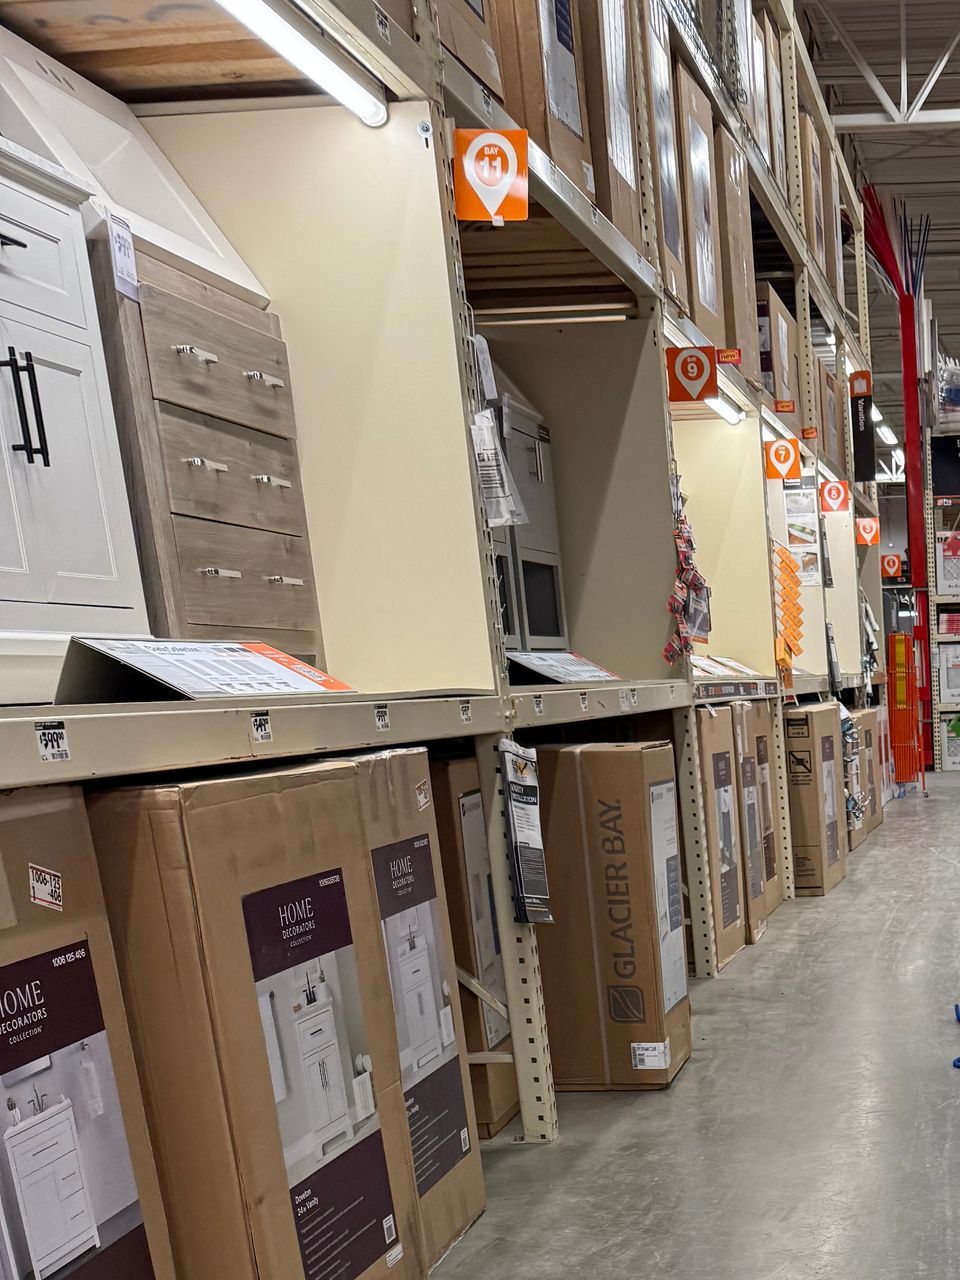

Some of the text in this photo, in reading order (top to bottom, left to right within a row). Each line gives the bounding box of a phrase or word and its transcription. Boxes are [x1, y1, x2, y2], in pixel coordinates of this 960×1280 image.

[480, 157, 502, 178] 11
[688, 363, 698, 377] 9
[778, 451, 786, 462] 7
[389, 855, 413, 878] HOME
[31, 869, 61, 890] 1006-125
[392, 875, 415, 889] DECORATORS
[278, 897, 314, 927] HOME
[604, 861, 637, 980] GLACIER
[282, 919, 316, 939] DECORATORS
[52, 955, 66, 968] 1006
[66, 951, 76, 963] 125
[9, 1026, 42, 1045] COLLECTION
